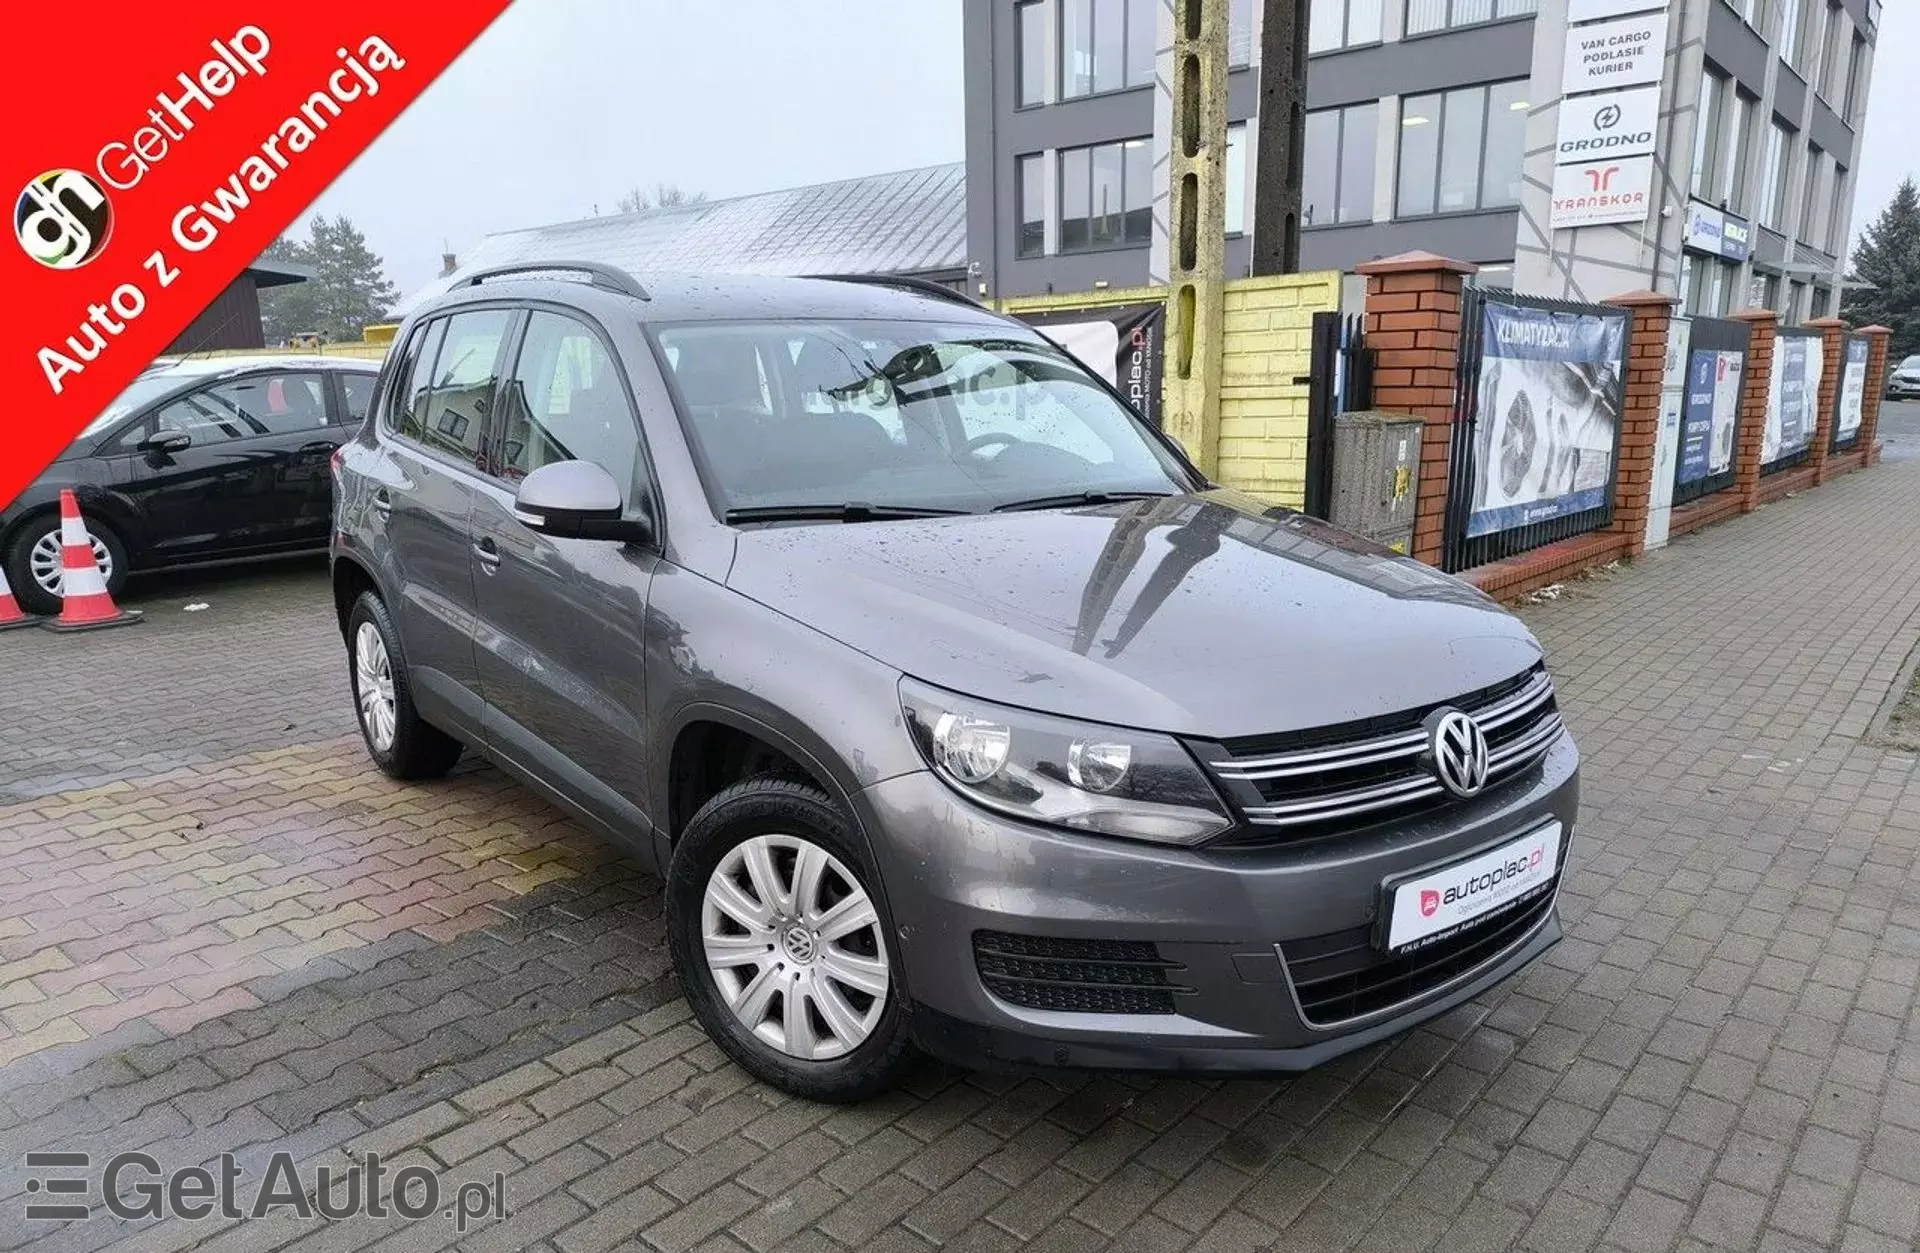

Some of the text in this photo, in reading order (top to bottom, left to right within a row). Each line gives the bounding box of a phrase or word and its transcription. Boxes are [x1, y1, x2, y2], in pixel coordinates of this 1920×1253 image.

[1581, 30, 1651, 50] VAN CARGO
[1583, 45, 1645, 63] PODLASIE
[1588, 61, 1633, 76] KURIER
[1560, 132, 1652, 152] GRODNO
[1443, 843, 1544, 905] autoplac.pl
